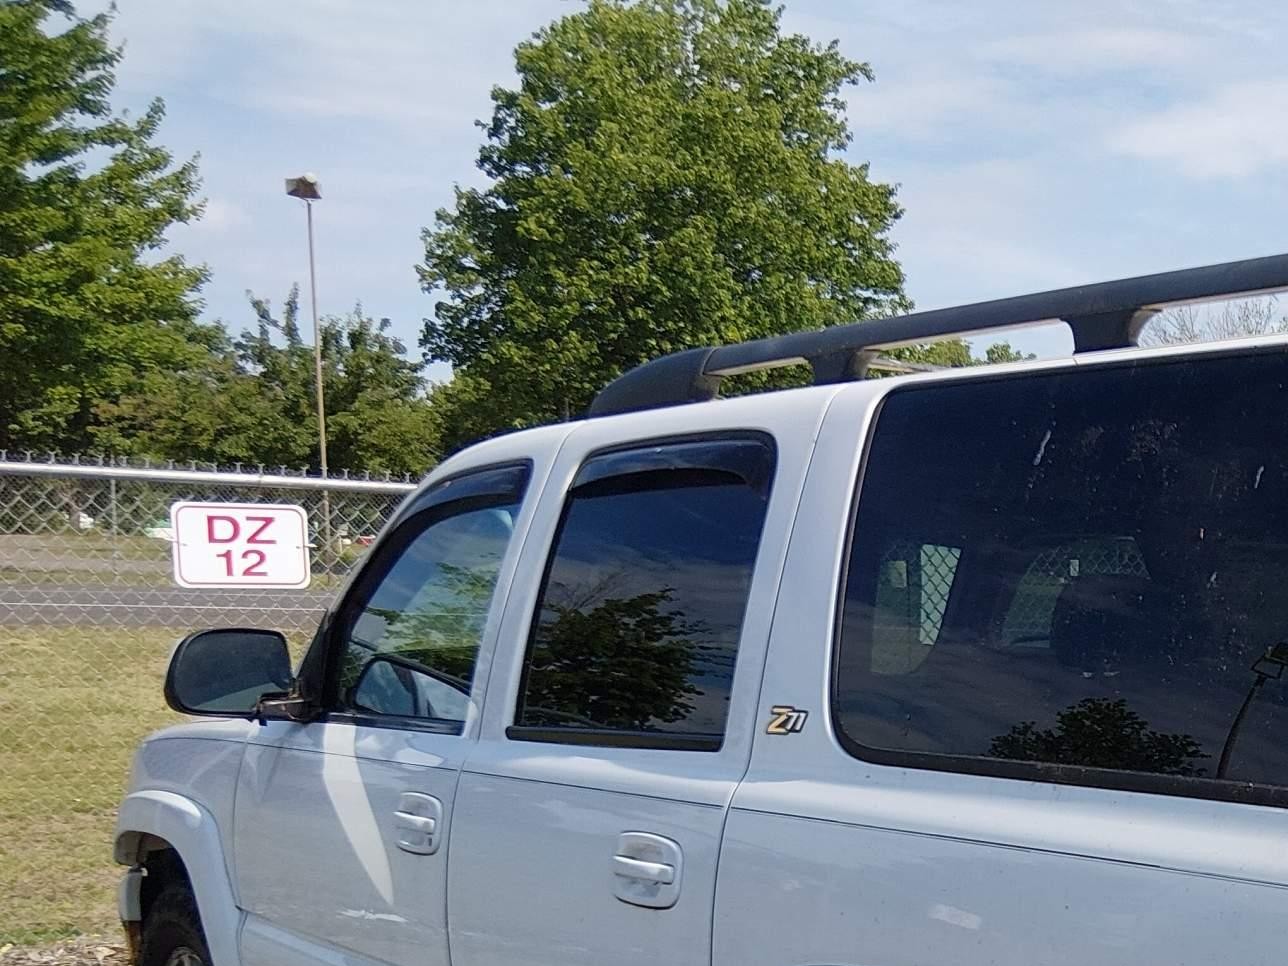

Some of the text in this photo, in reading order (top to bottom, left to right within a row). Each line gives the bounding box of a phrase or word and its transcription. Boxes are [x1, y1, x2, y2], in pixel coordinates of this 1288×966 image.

[206, 515, 277, 544] DZ
[215, 549, 268, 577] 12
[766, 705, 808, 735] Z71
